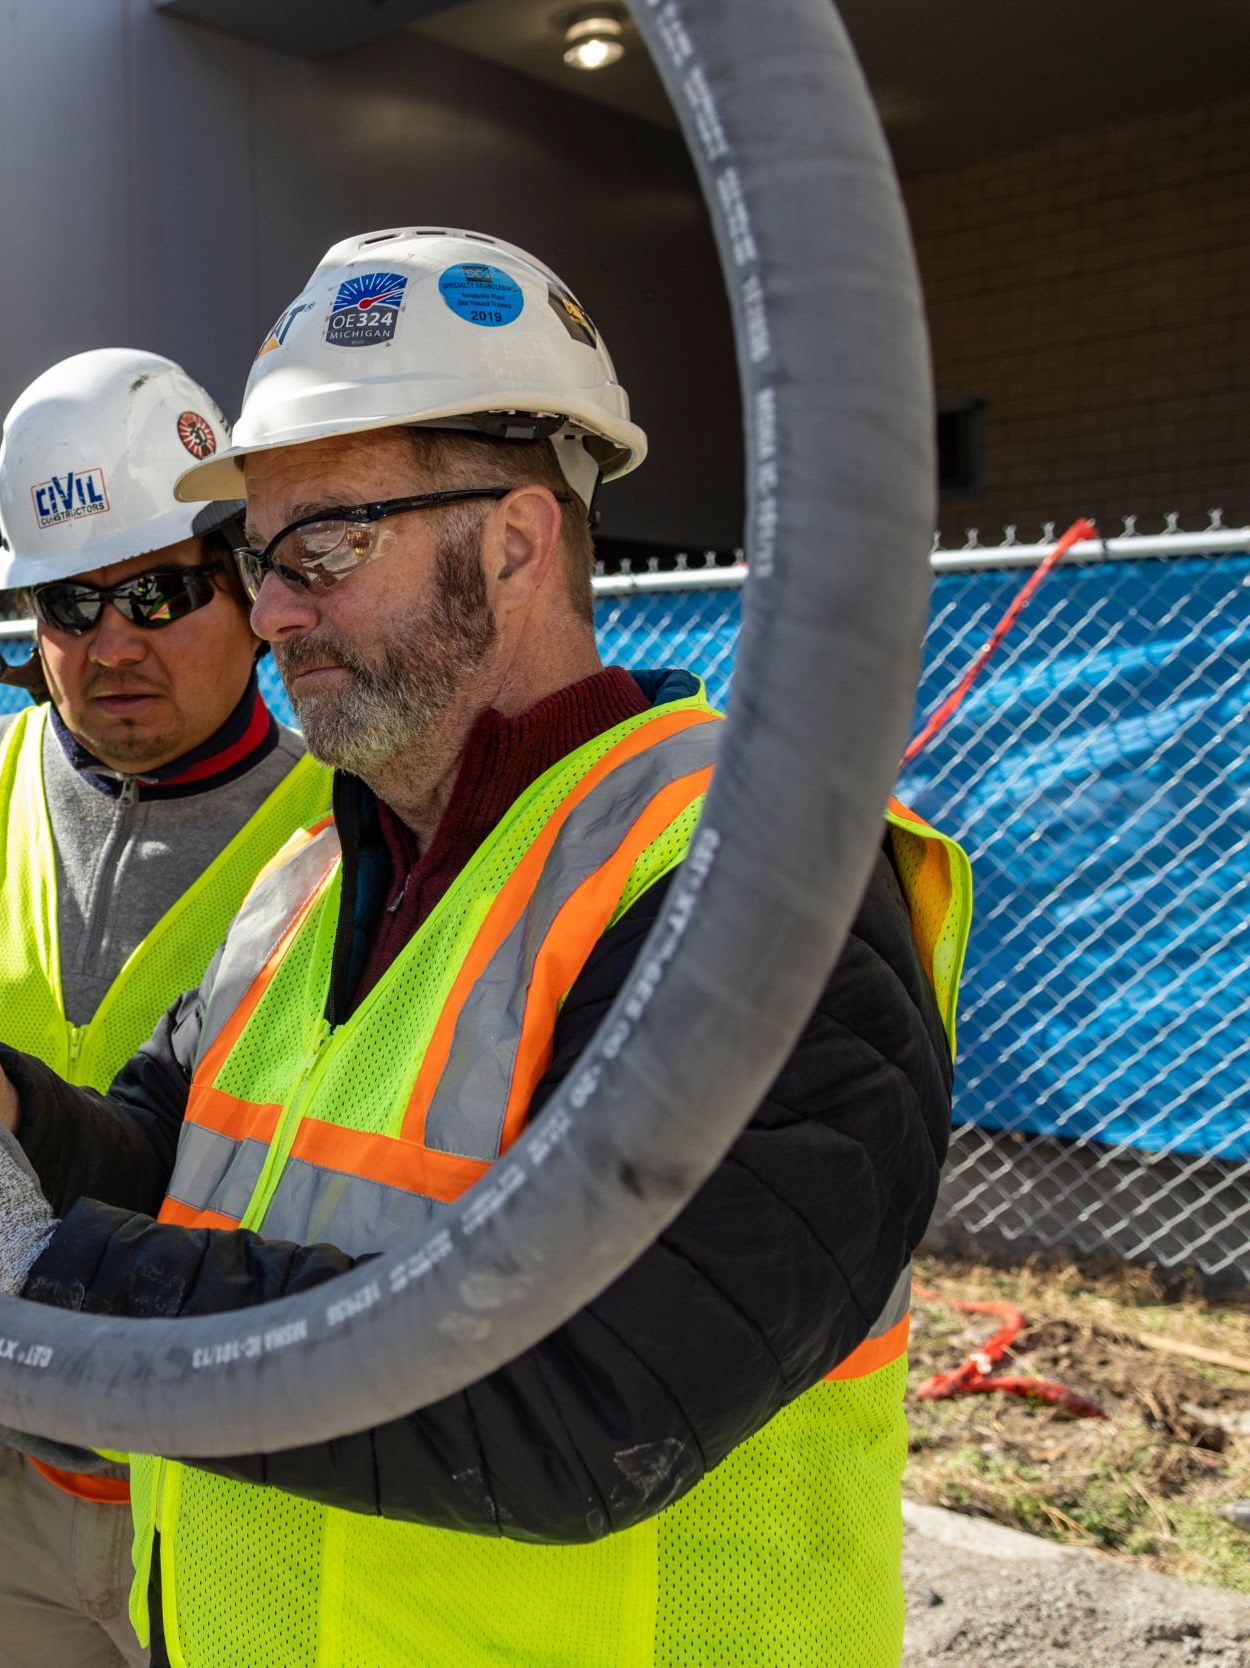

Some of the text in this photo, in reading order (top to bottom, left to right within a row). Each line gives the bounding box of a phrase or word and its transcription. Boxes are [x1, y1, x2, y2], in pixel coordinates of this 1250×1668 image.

[442, 282, 474, 290] SPECIALTY
[332, 312, 393, 329] OE324
[471, 310, 502, 322] 2019
[330, 329, 390, 340] MICHIGAN
[36, 472, 103, 516] CIVIL
[41, 502, 105, 526] CONSTRUCTORS
